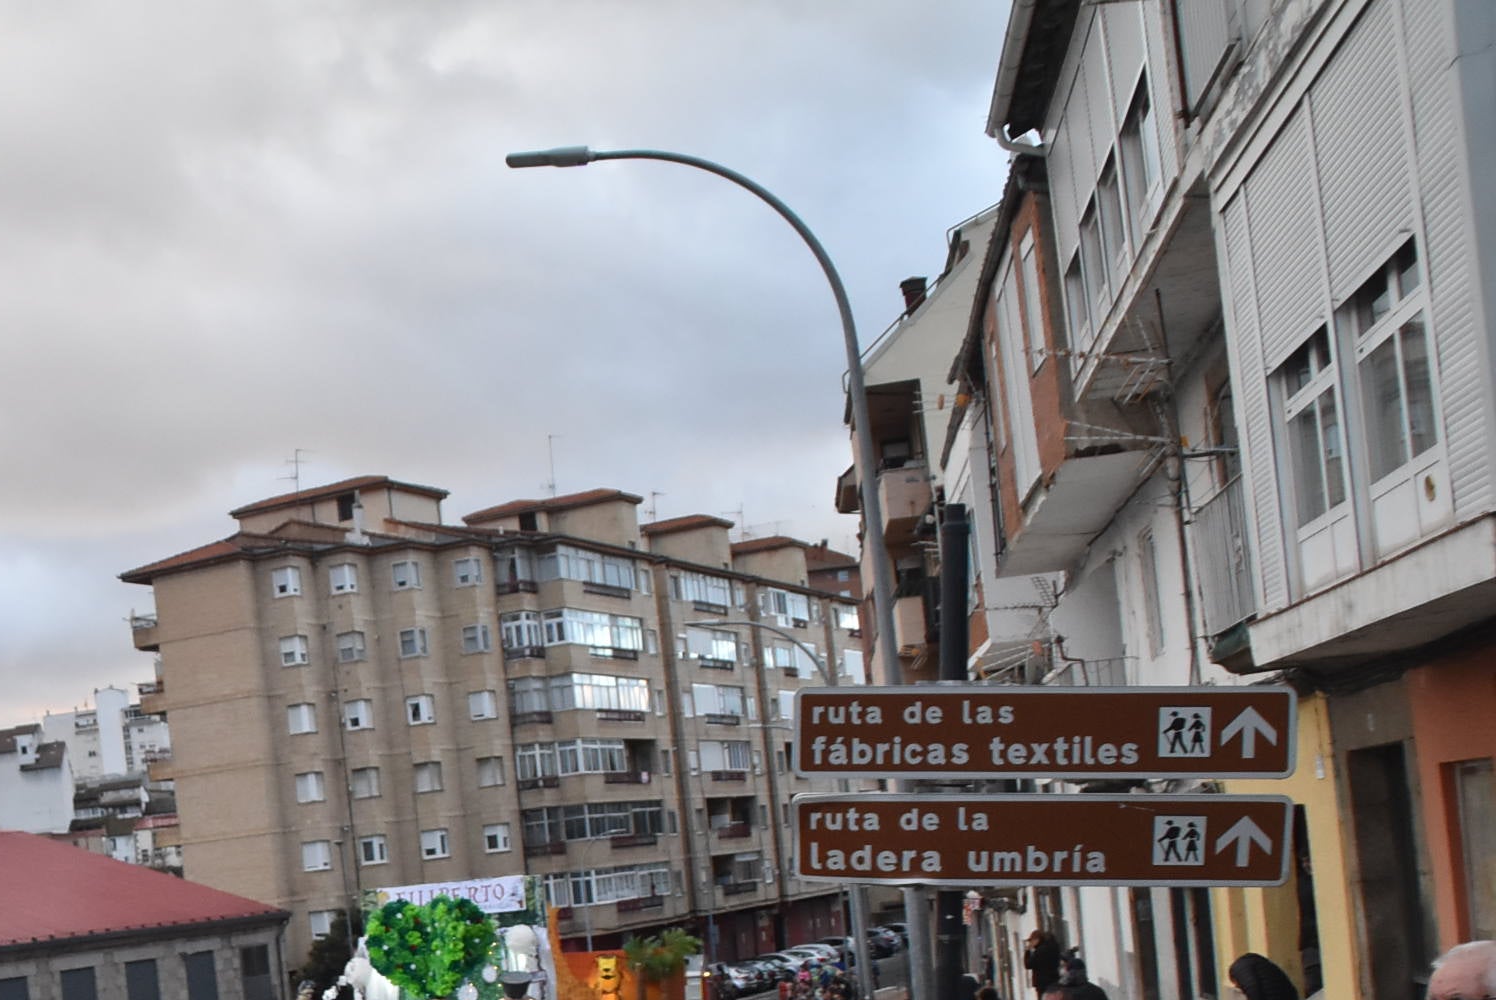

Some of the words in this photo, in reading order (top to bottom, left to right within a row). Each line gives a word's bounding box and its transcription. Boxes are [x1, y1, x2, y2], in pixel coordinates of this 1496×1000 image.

[812, 701, 883, 724] ruta
[903, 701, 943, 724] de
[962, 701, 1014, 724] las
[811, 736, 969, 765] fábricas
[990, 736, 1138, 766] textiles
[810, 807, 880, 831] ruta
[900, 808, 940, 831] de
[958, 807, 989, 831] la
[810, 843, 942, 873] ladera
[968, 844, 1106, 873] umbría
